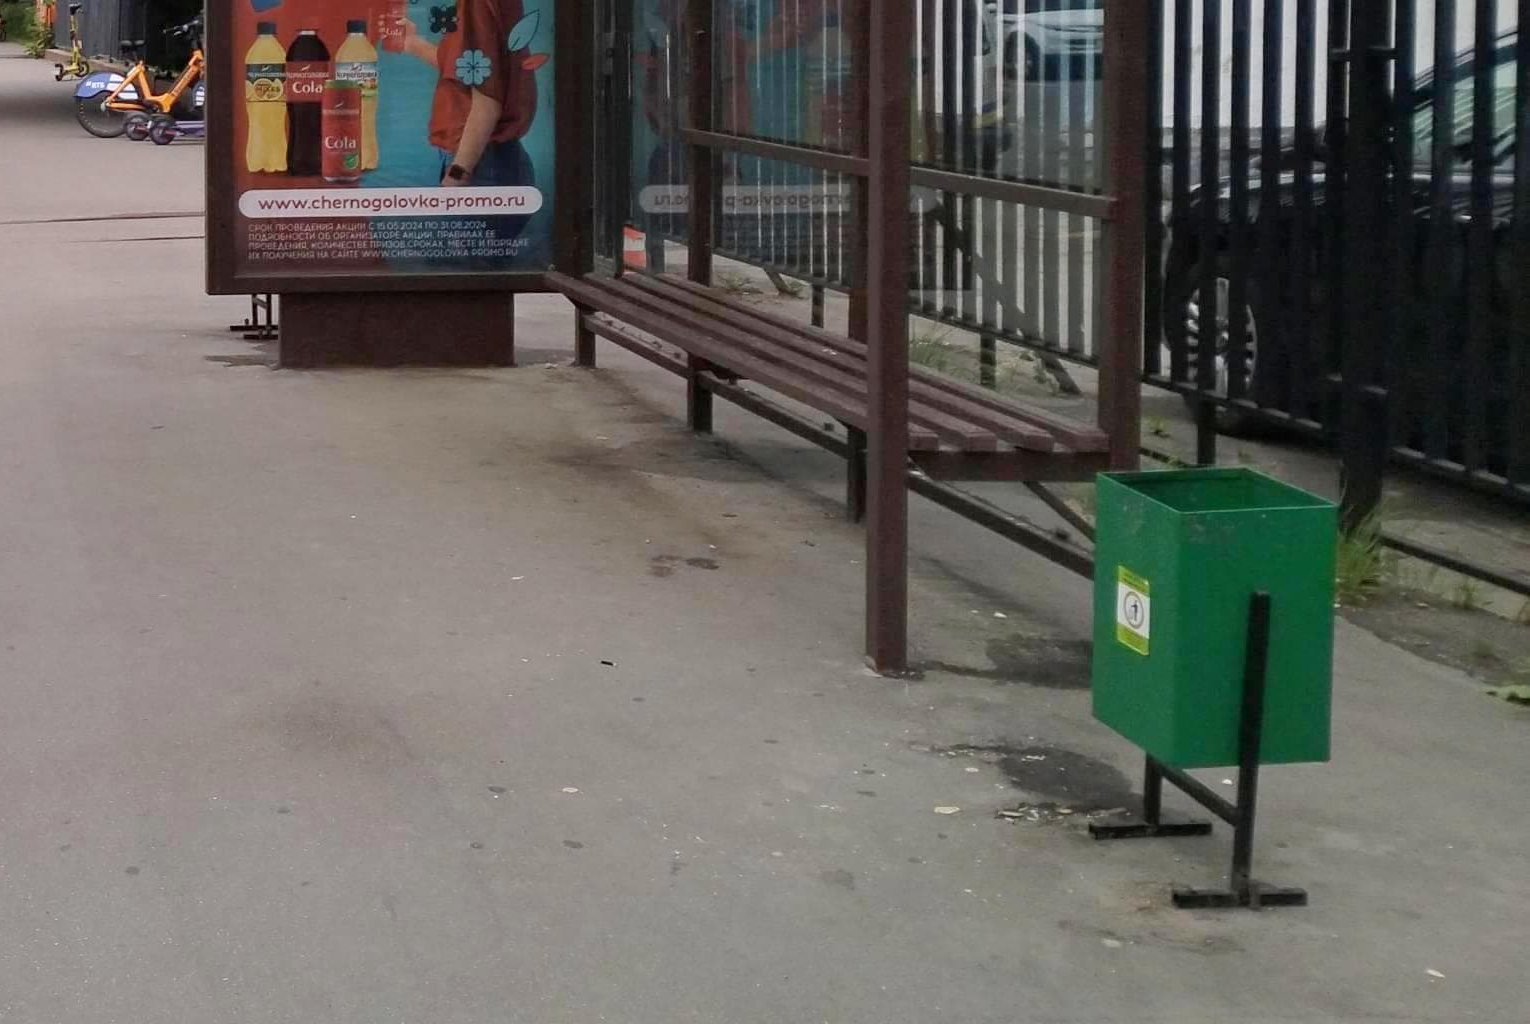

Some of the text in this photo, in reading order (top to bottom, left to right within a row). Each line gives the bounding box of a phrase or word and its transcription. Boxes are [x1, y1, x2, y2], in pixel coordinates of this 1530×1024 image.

[292, 81, 323, 94] Cola
[324, 135, 357, 149] Cola
[258, 195, 525, 212] www.chernogolovka-promo.ru
[248, 224, 273, 232] СРОК
[275, 223, 334, 232] ПРОВЕДЕНИЯ
[424, 221, 439, 230] ПО
[248, 232, 316, 242] ПОДРОБНОСТИ
[333, 231, 400, 241] ОРГАНИЗАТОРЕ
